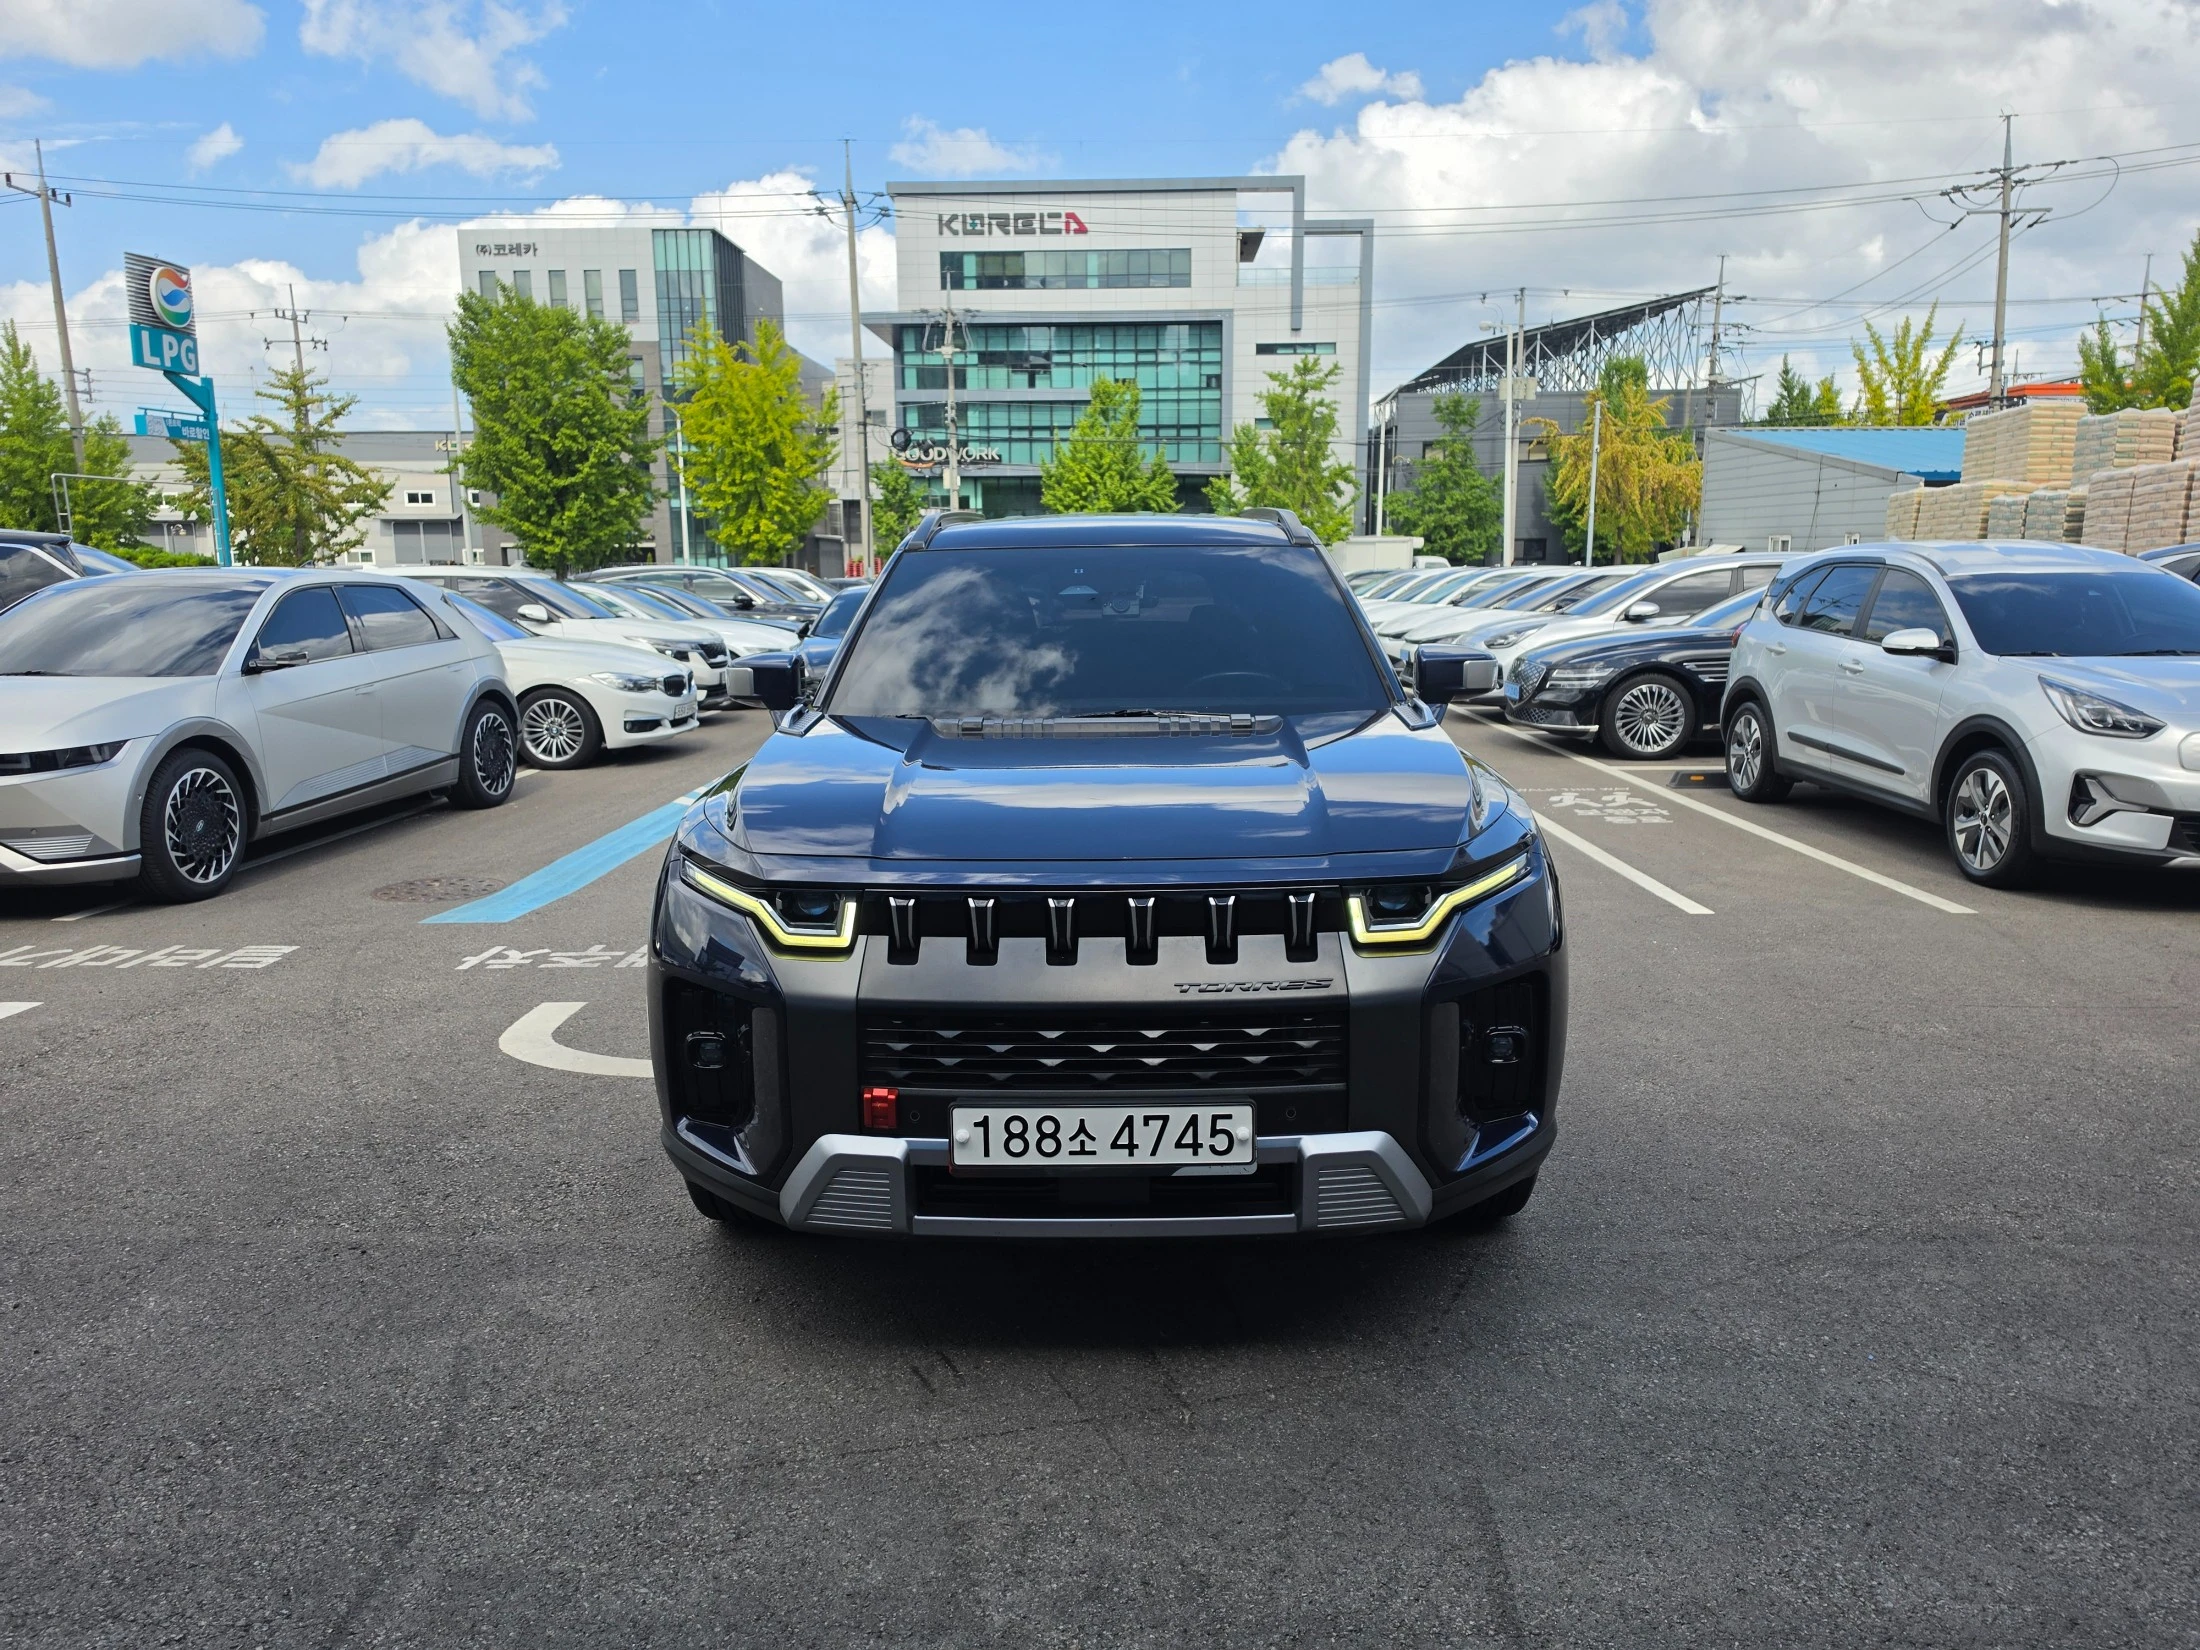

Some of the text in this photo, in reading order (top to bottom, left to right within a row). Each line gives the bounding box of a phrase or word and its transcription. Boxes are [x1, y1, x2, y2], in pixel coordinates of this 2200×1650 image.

[938, 211, 1088, 236] KORECA
[475, 242, 538, 257] (주)코레카
[141, 330, 197, 372] LPG
[181, 426, 210, 440] 바로할인
[1174, 978, 1334, 994] TORRES
